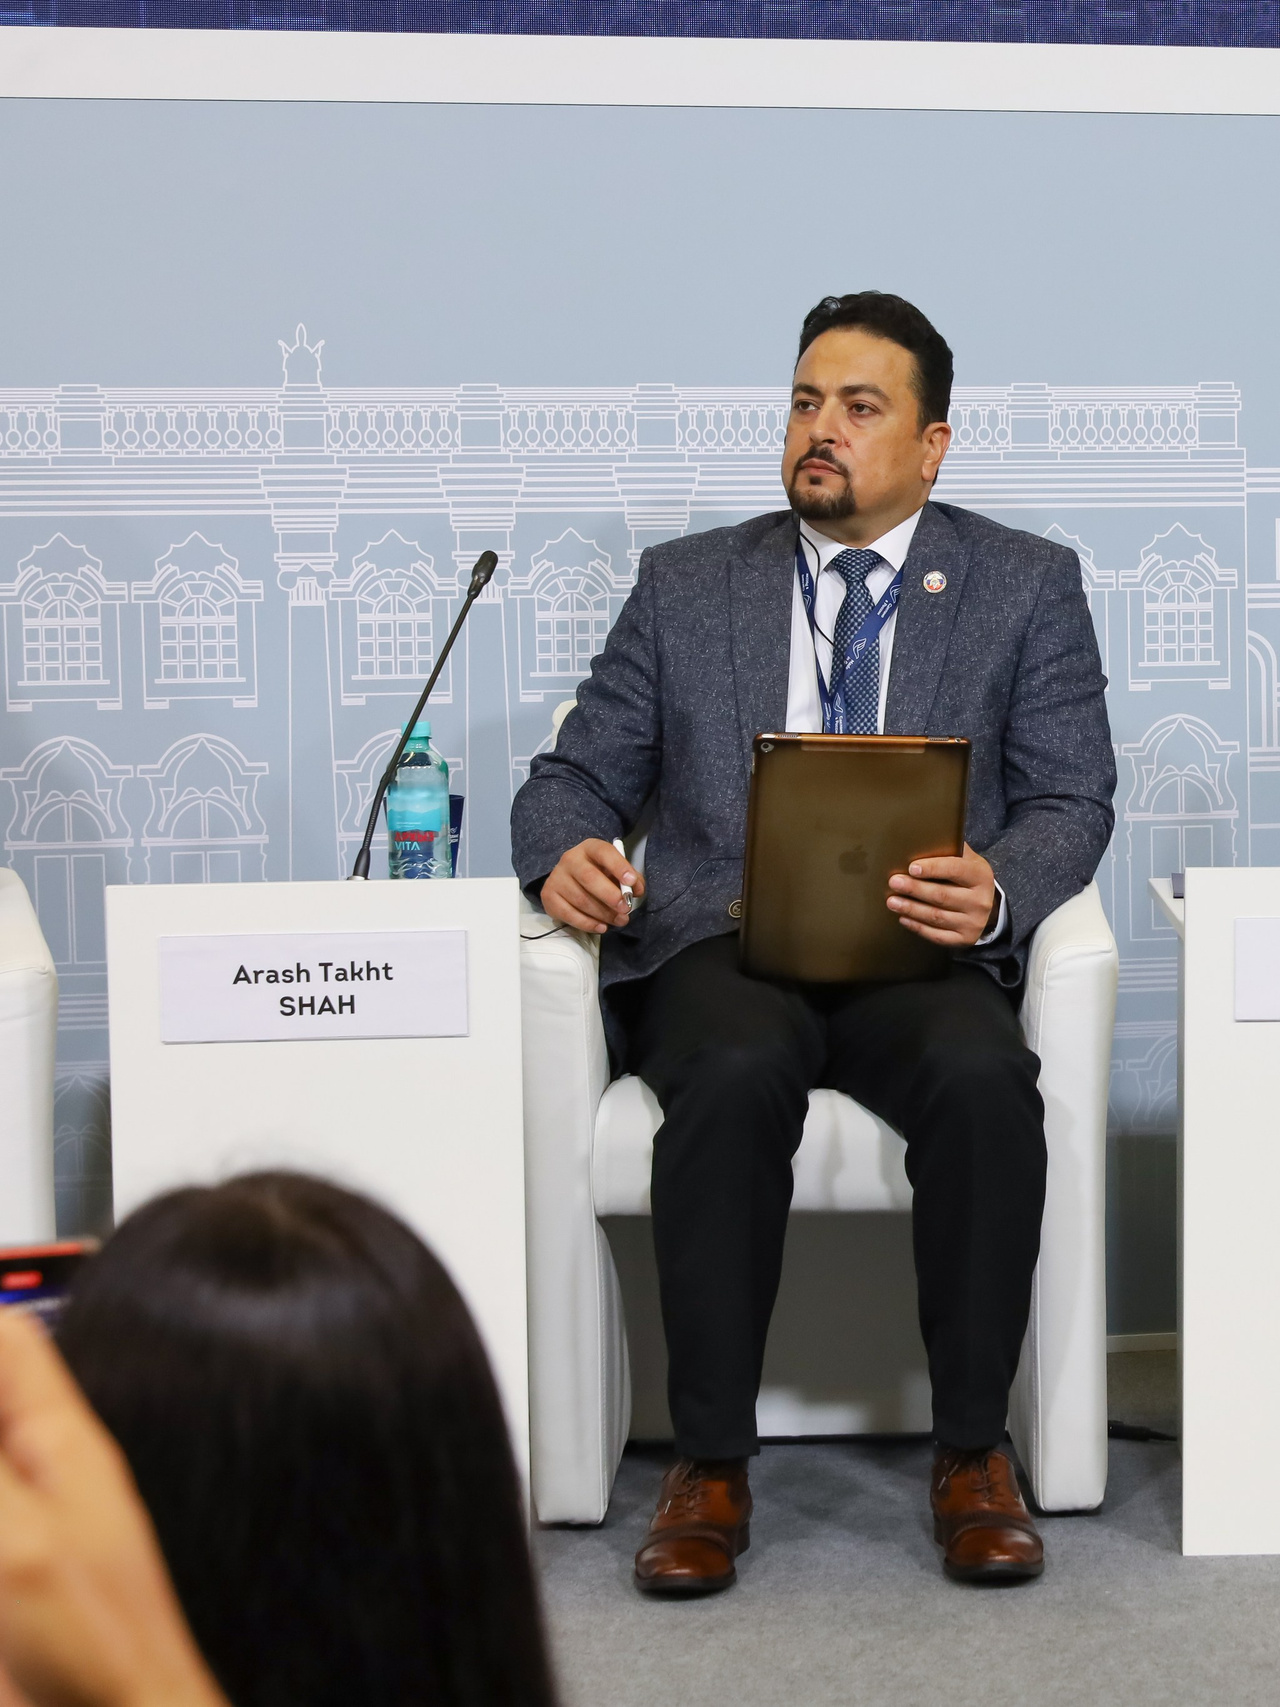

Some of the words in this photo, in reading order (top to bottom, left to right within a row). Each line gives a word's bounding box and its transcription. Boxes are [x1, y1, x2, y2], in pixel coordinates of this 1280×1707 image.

[394, 841, 421, 851] VITA
[232, 962, 311, 985] Arash
[318, 960, 394, 983] Takht
[279, 994, 356, 1017] SHAH
